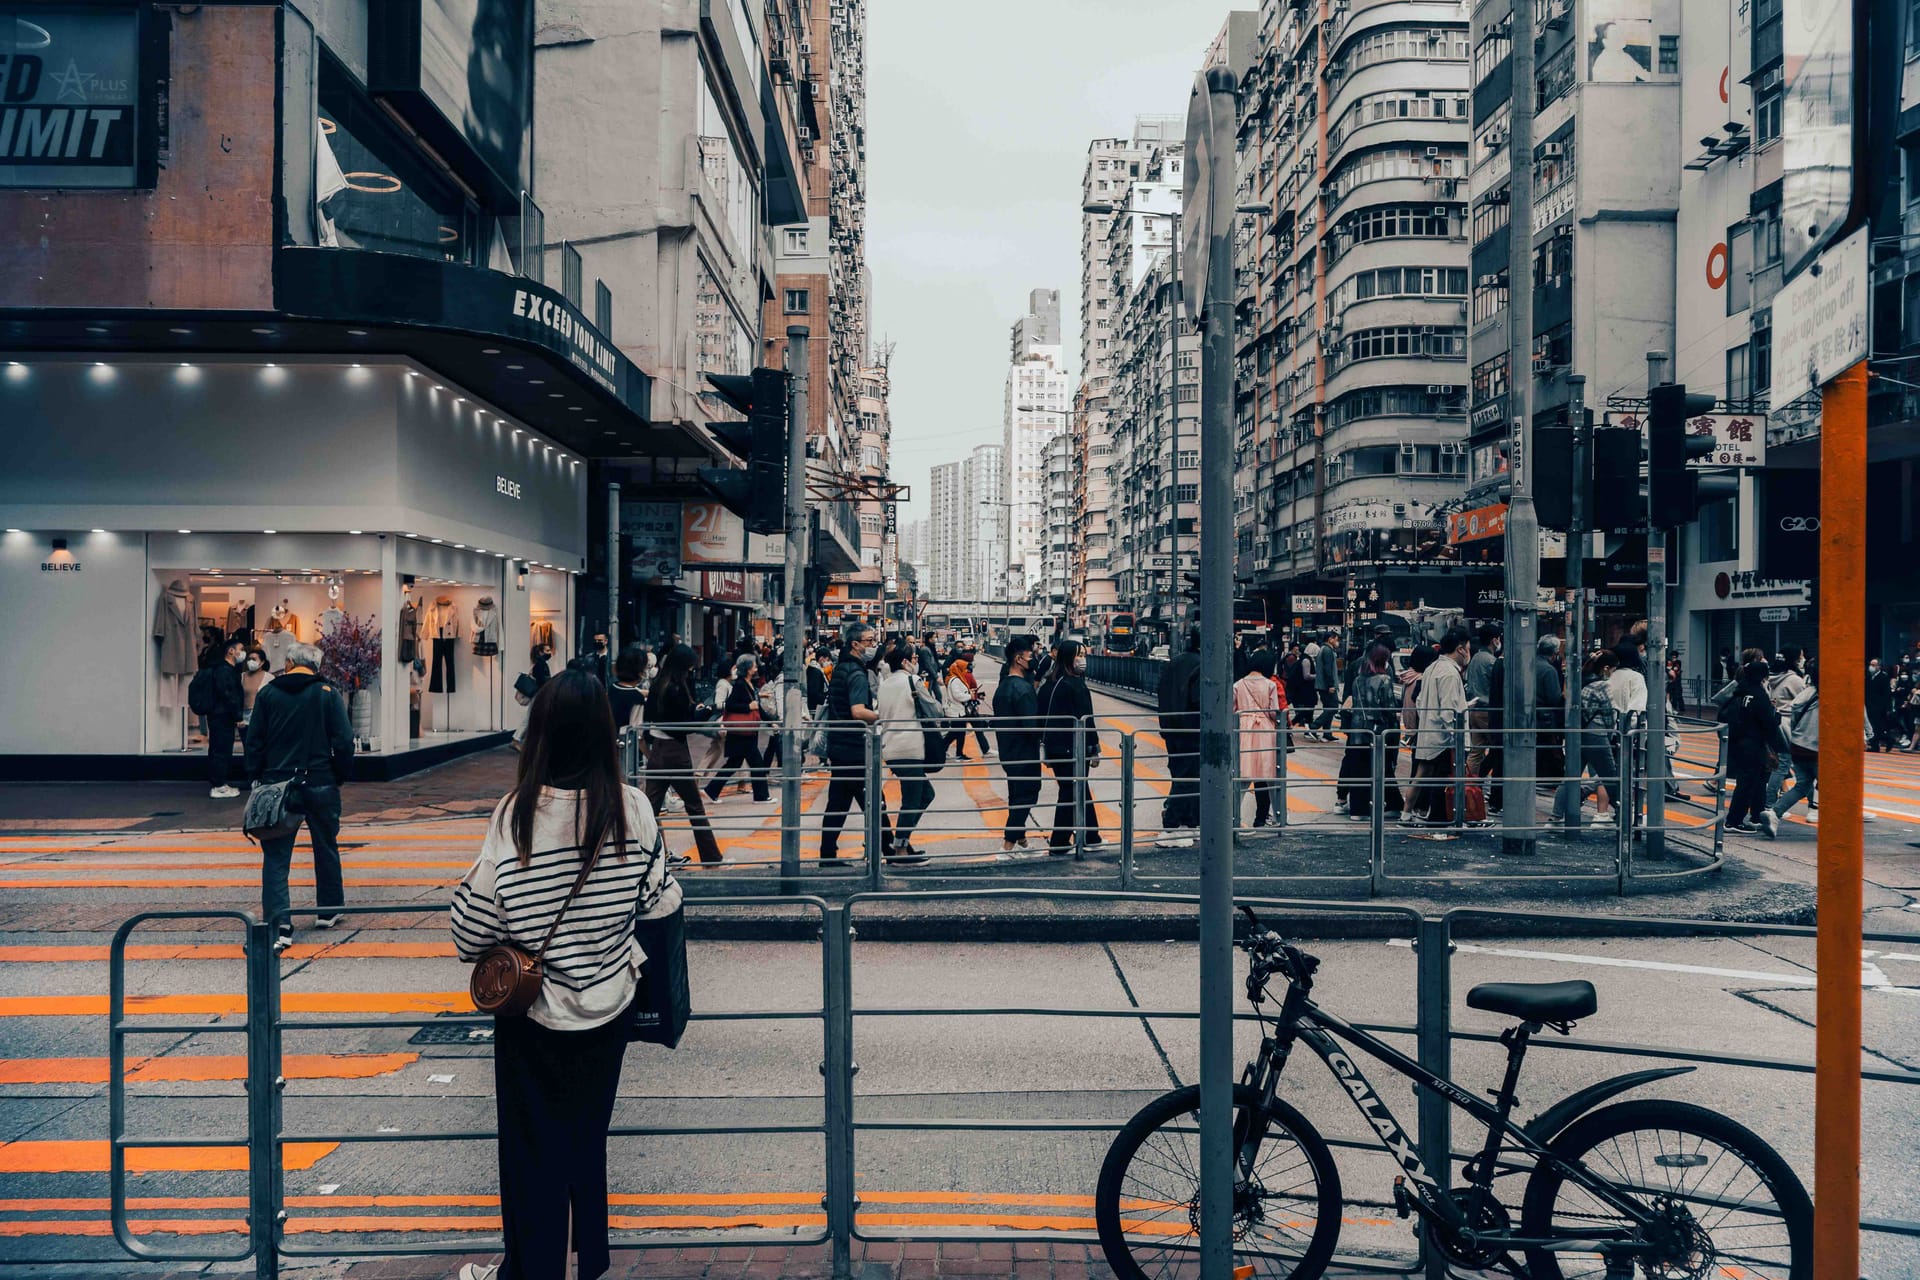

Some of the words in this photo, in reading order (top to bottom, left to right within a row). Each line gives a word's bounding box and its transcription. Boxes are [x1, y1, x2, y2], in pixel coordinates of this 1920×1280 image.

[0, 54, 43, 102] D
[91, 79, 128, 92] PLUS
[1824, 253, 1843, 292] taxi
[1839, 276, 1855, 311] off
[513, 289, 572, 339] EXCEED
[574, 320, 595, 359] YOUR
[596, 341, 616, 377] LIMIT
[496, 475, 521, 500] BELIEVE
[41, 562, 82, 572] BELIEVE
[1328, 1051, 1439, 1188] GALAXY
[1417, 1182, 1437, 1205] CYCLE
